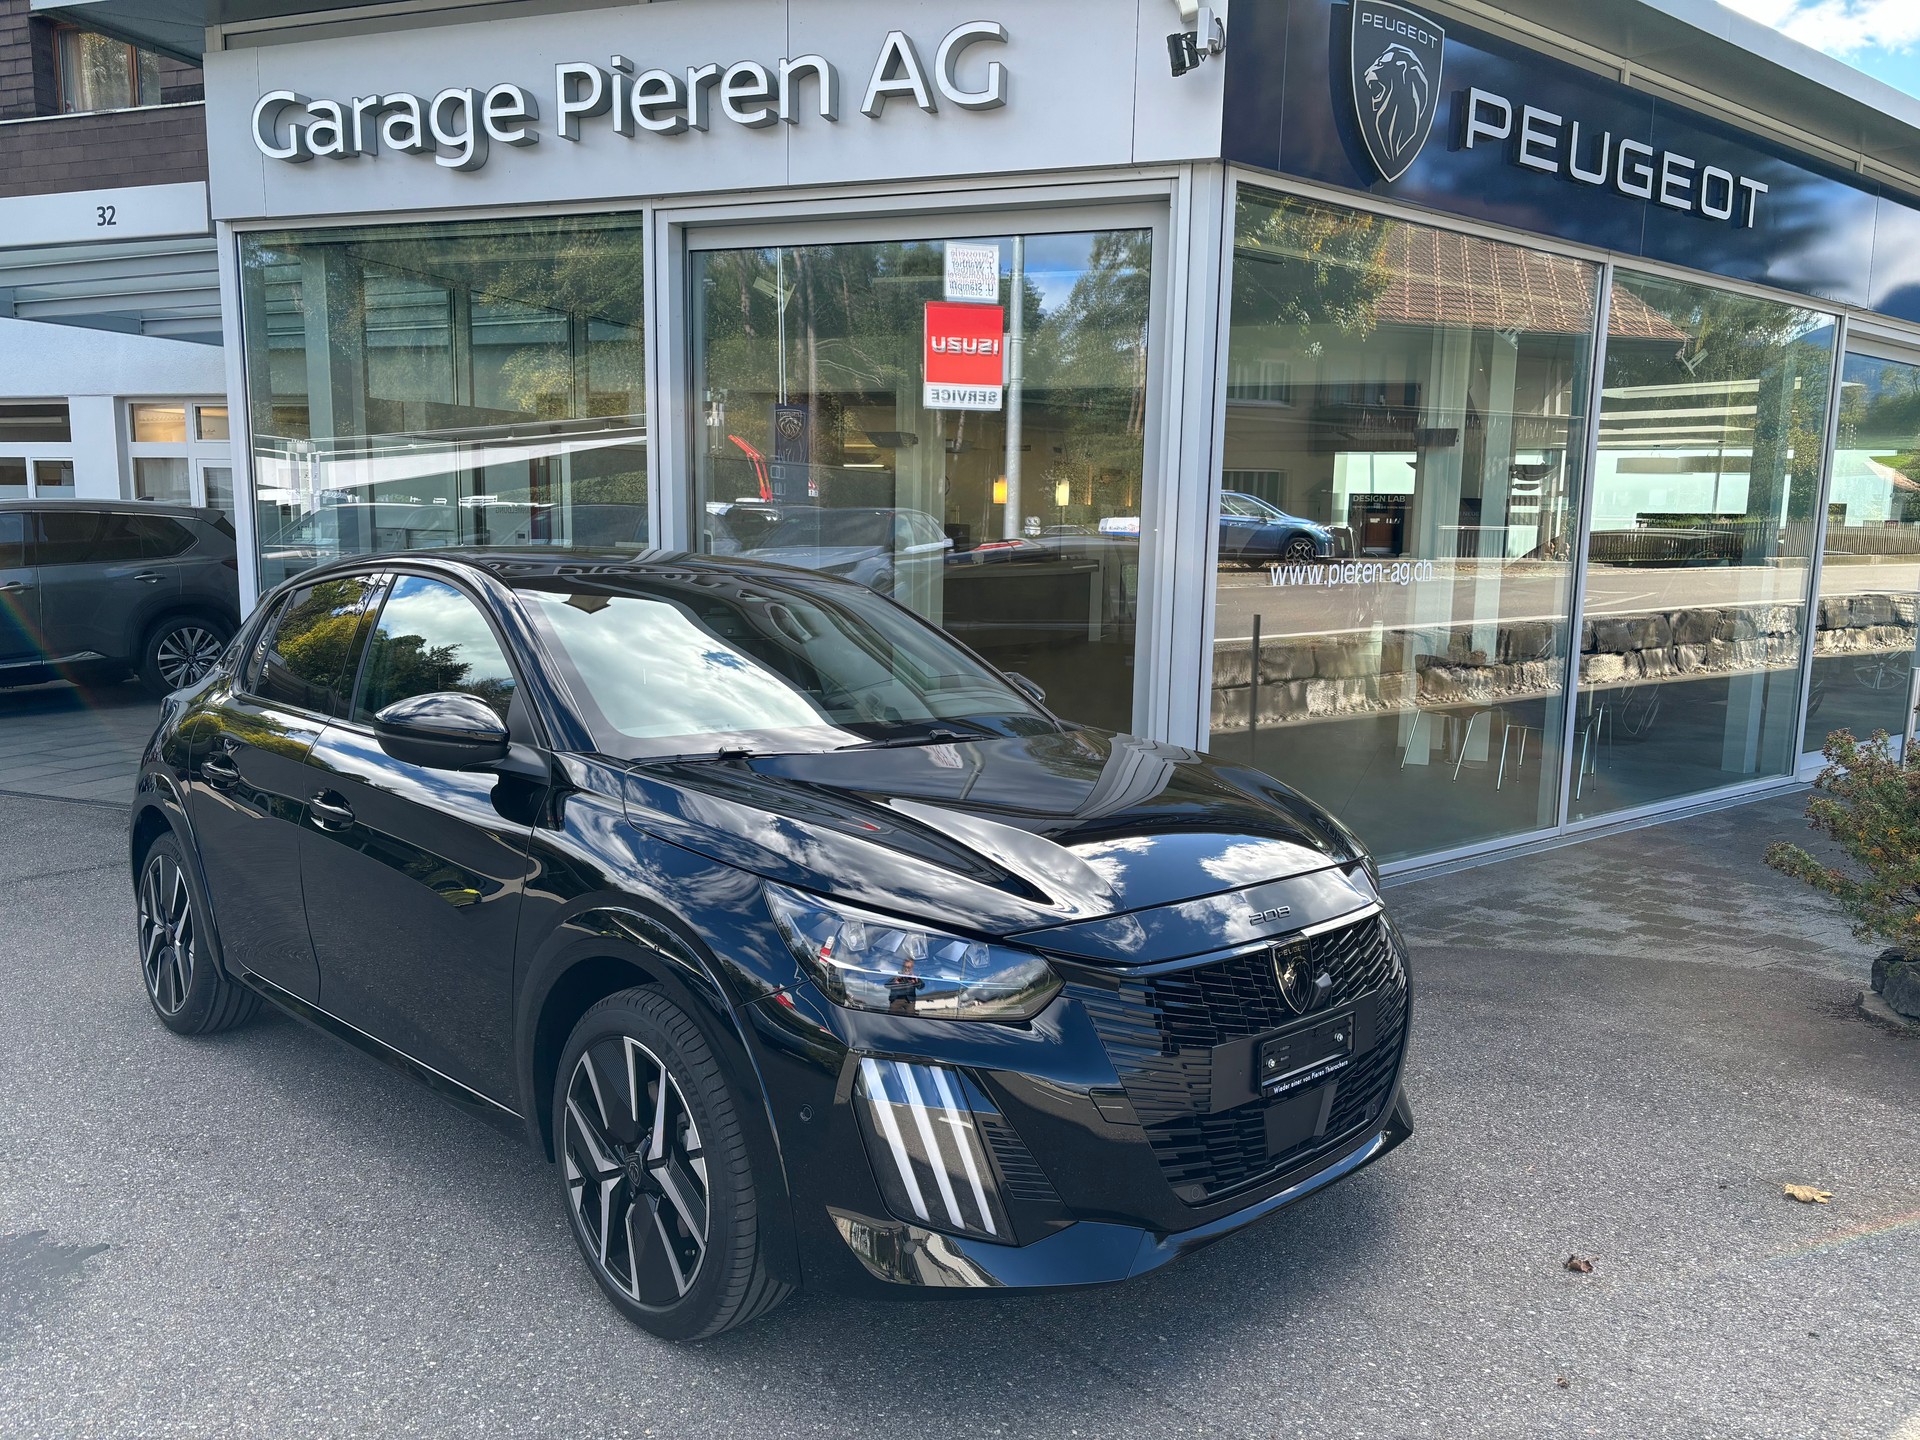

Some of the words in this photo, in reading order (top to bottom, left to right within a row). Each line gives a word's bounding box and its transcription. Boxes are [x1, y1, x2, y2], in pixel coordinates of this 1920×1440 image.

[1361, 12, 1438, 48] PEUGEOT
[252, 82, 539, 171] Garage
[555, 55, 839, 141] Pieren
[860, 20, 1008, 118] AG
[1465, 86, 1769, 228] PEUGEOT
[96, 205, 117, 226] 32
[1352, 494, 1386, 503] DESIGN
[1387, 495, 1406, 503] LAB
[1270, 559, 1433, 588] www.pieren-ag.ch
[1249, 905, 1291, 926] 208
[1277, 944, 1309, 958] PEUGEOT
[1273, 1082, 1291, 1094] Wieder
[1290, 1079, 1302, 1088] einer
[1311, 1069, 1325, 1080] Pieren
[668, 1050, 714, 1142] MICHELIN
